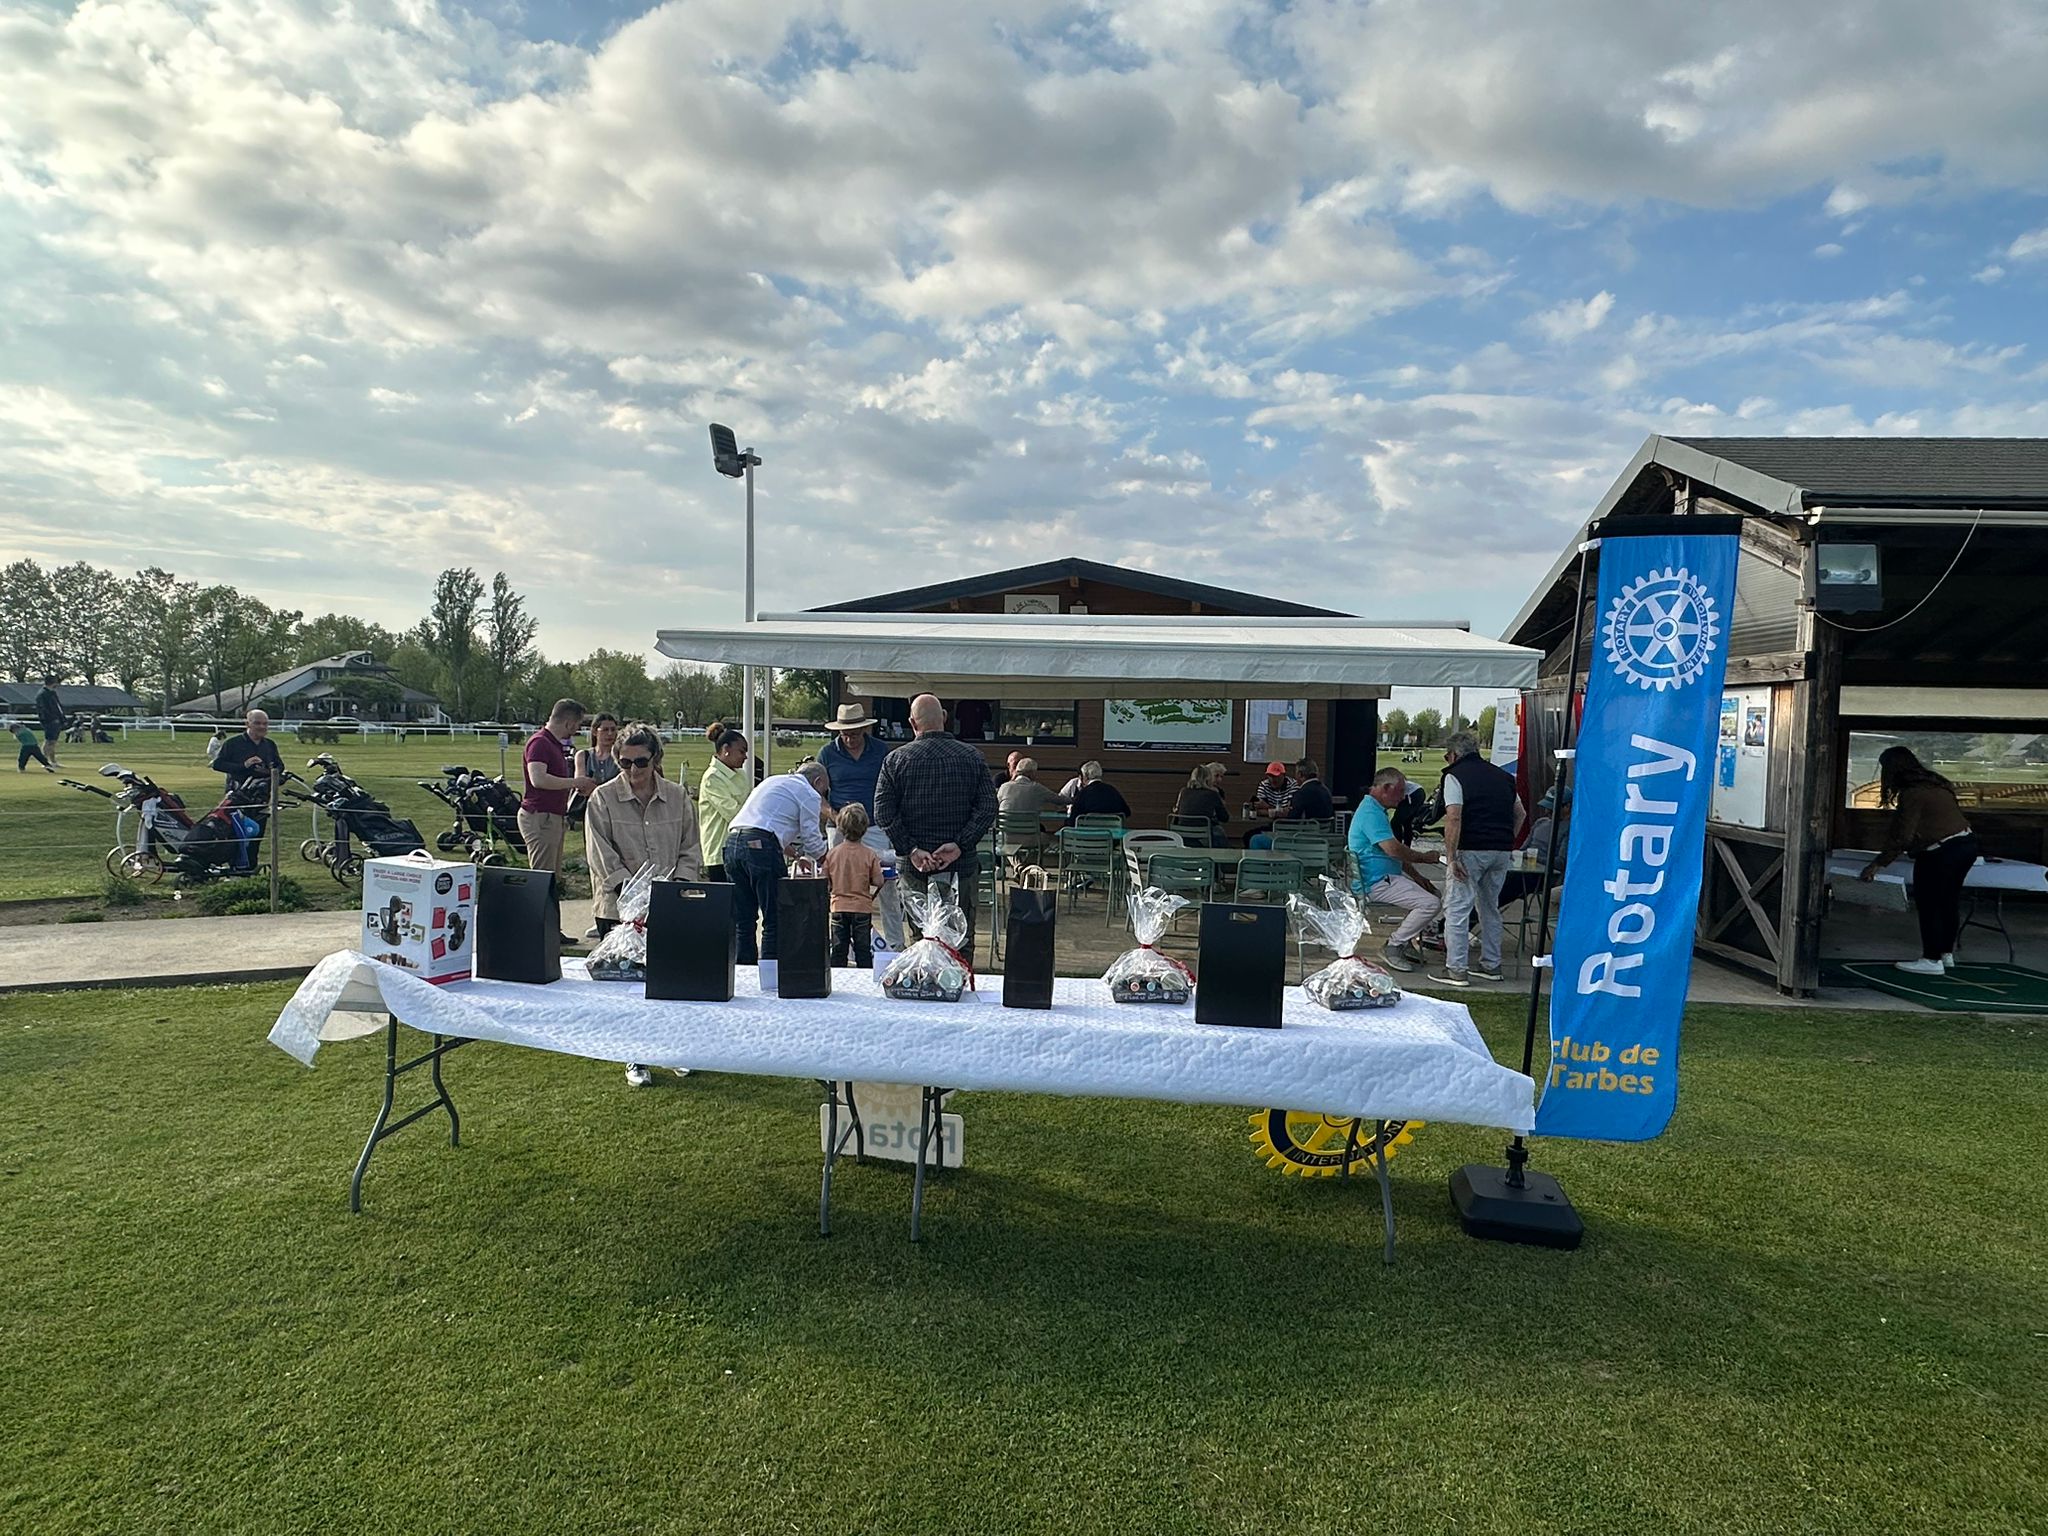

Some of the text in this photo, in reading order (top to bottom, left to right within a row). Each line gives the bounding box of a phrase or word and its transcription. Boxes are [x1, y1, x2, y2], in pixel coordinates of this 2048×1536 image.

[1615, 604, 1631, 656] ROTARY
[1683, 585, 1709, 672] INTERNATIONAL
[1577, 734, 1697, 998] Rotary
[1619, 1043, 1660, 1066] de
